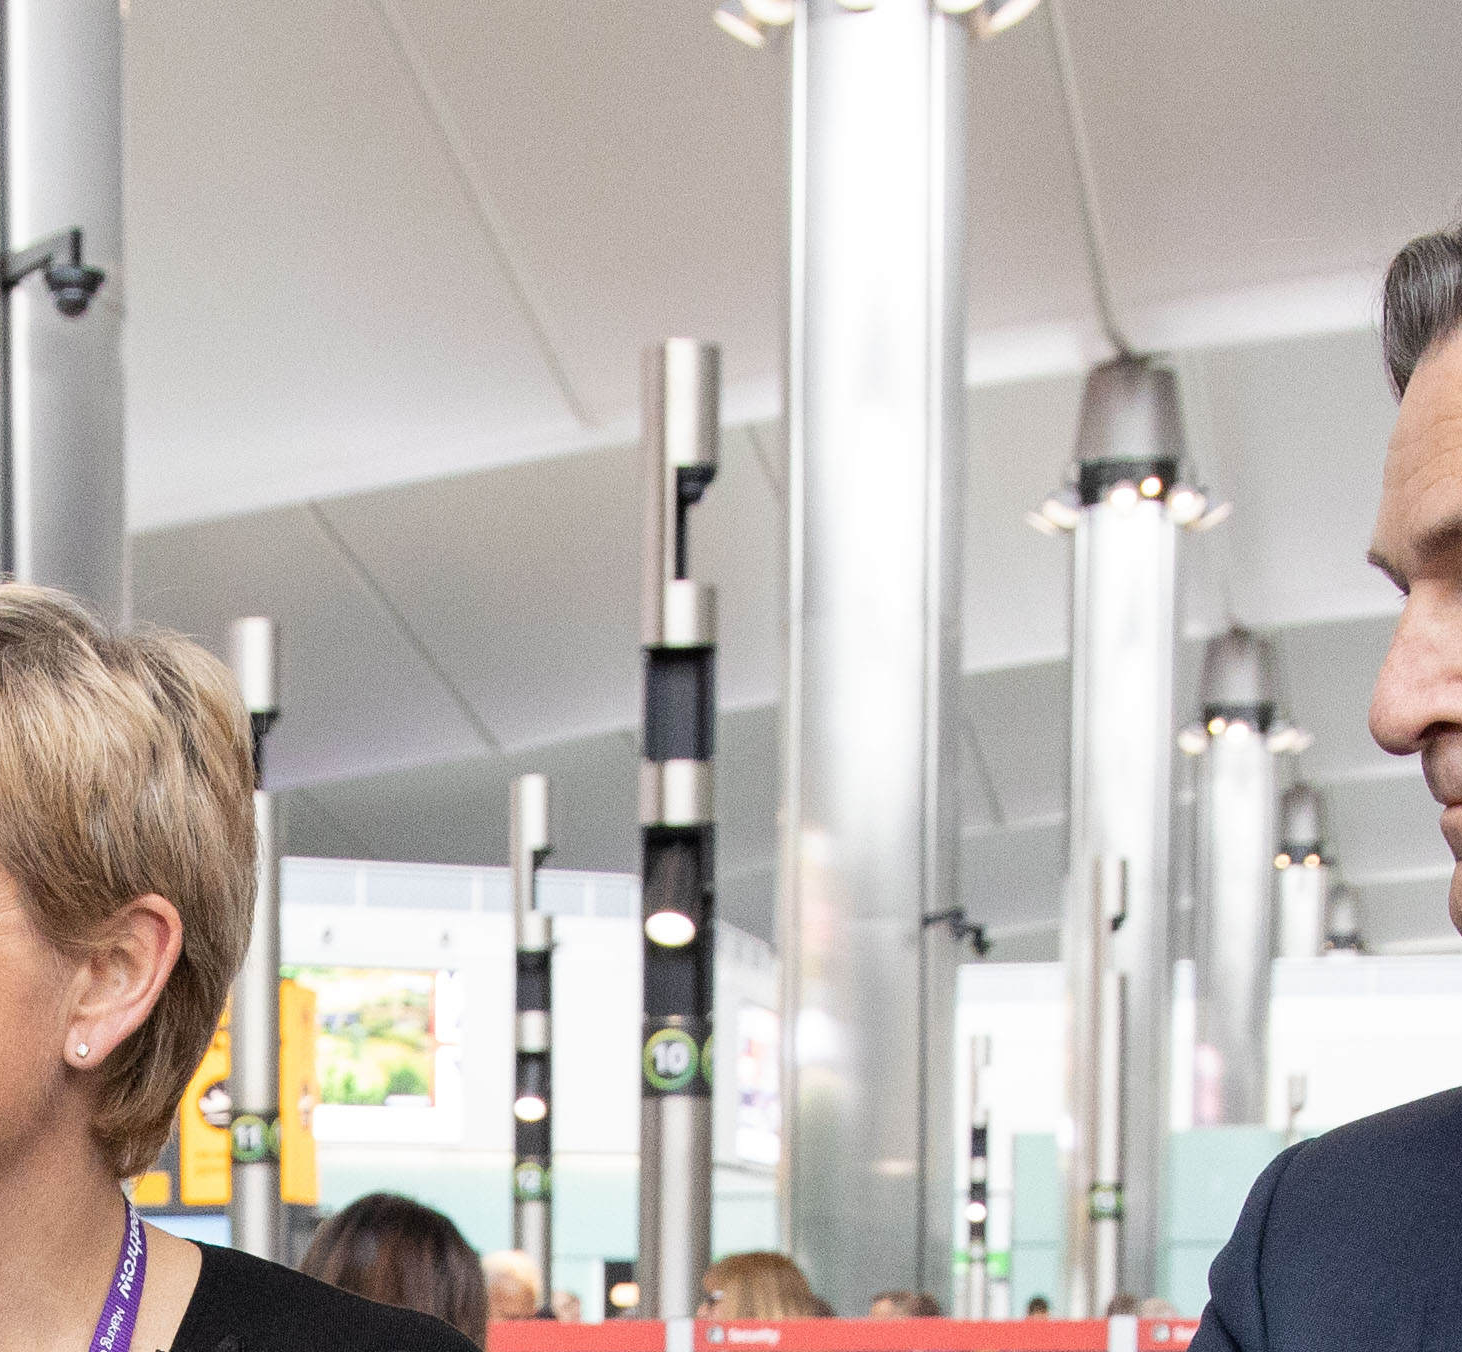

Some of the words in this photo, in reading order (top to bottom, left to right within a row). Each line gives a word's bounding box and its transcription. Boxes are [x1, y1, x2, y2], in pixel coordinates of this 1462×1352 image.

[653, 1042, 690, 1075] 10
[236, 1122, 262, 1151] 11
[100, 1305, 126, 1347] Making
